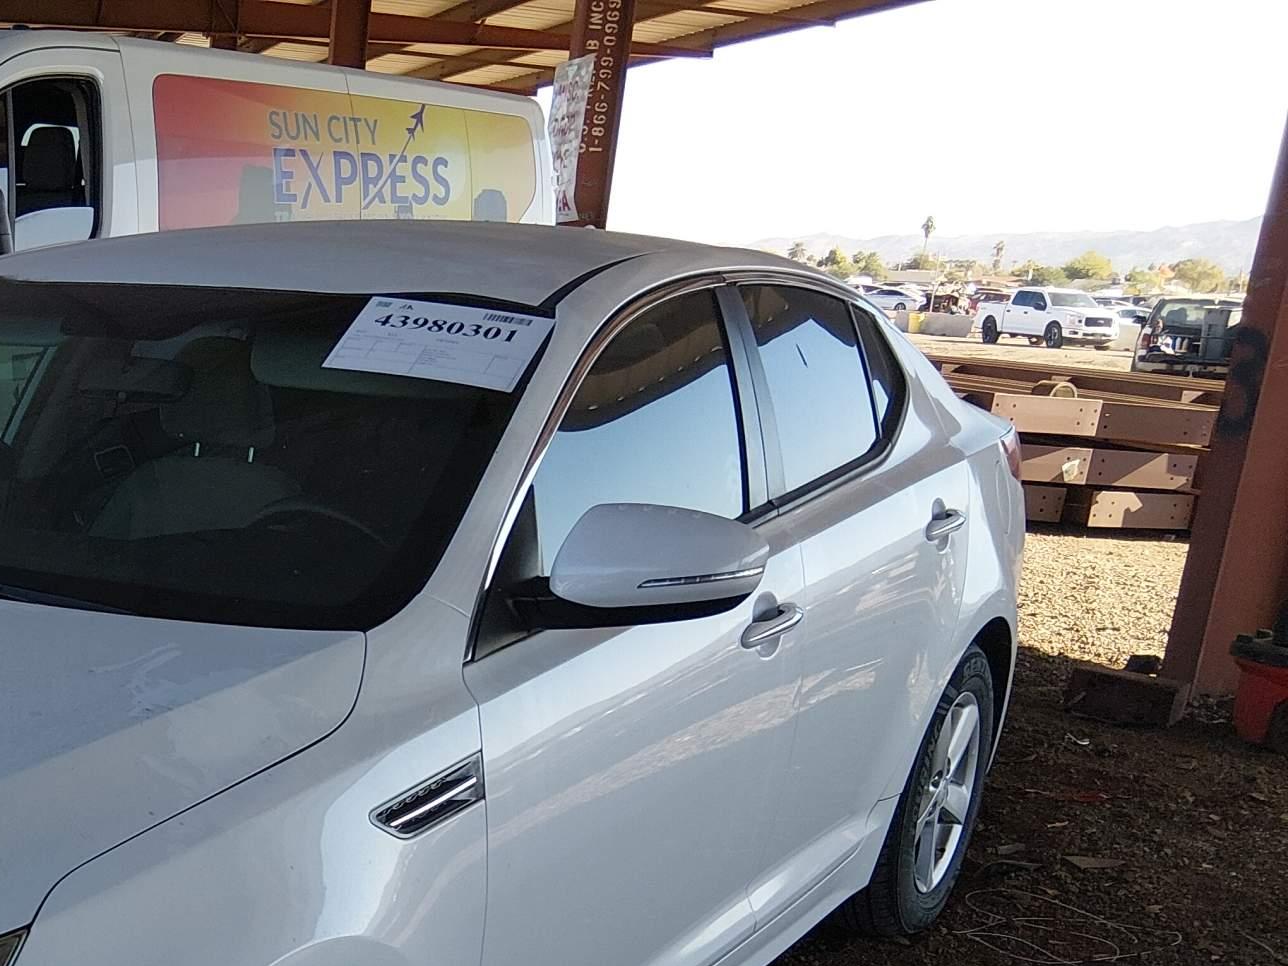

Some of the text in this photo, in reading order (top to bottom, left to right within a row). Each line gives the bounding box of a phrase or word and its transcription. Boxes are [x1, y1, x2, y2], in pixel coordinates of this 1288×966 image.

[589, 0, 622, 152] 1-866-799-0969
[269, 110, 379, 146] SUN CITY
[272, 147, 452, 210] EXPRESS
[374, 313, 519, 343] 43980301
